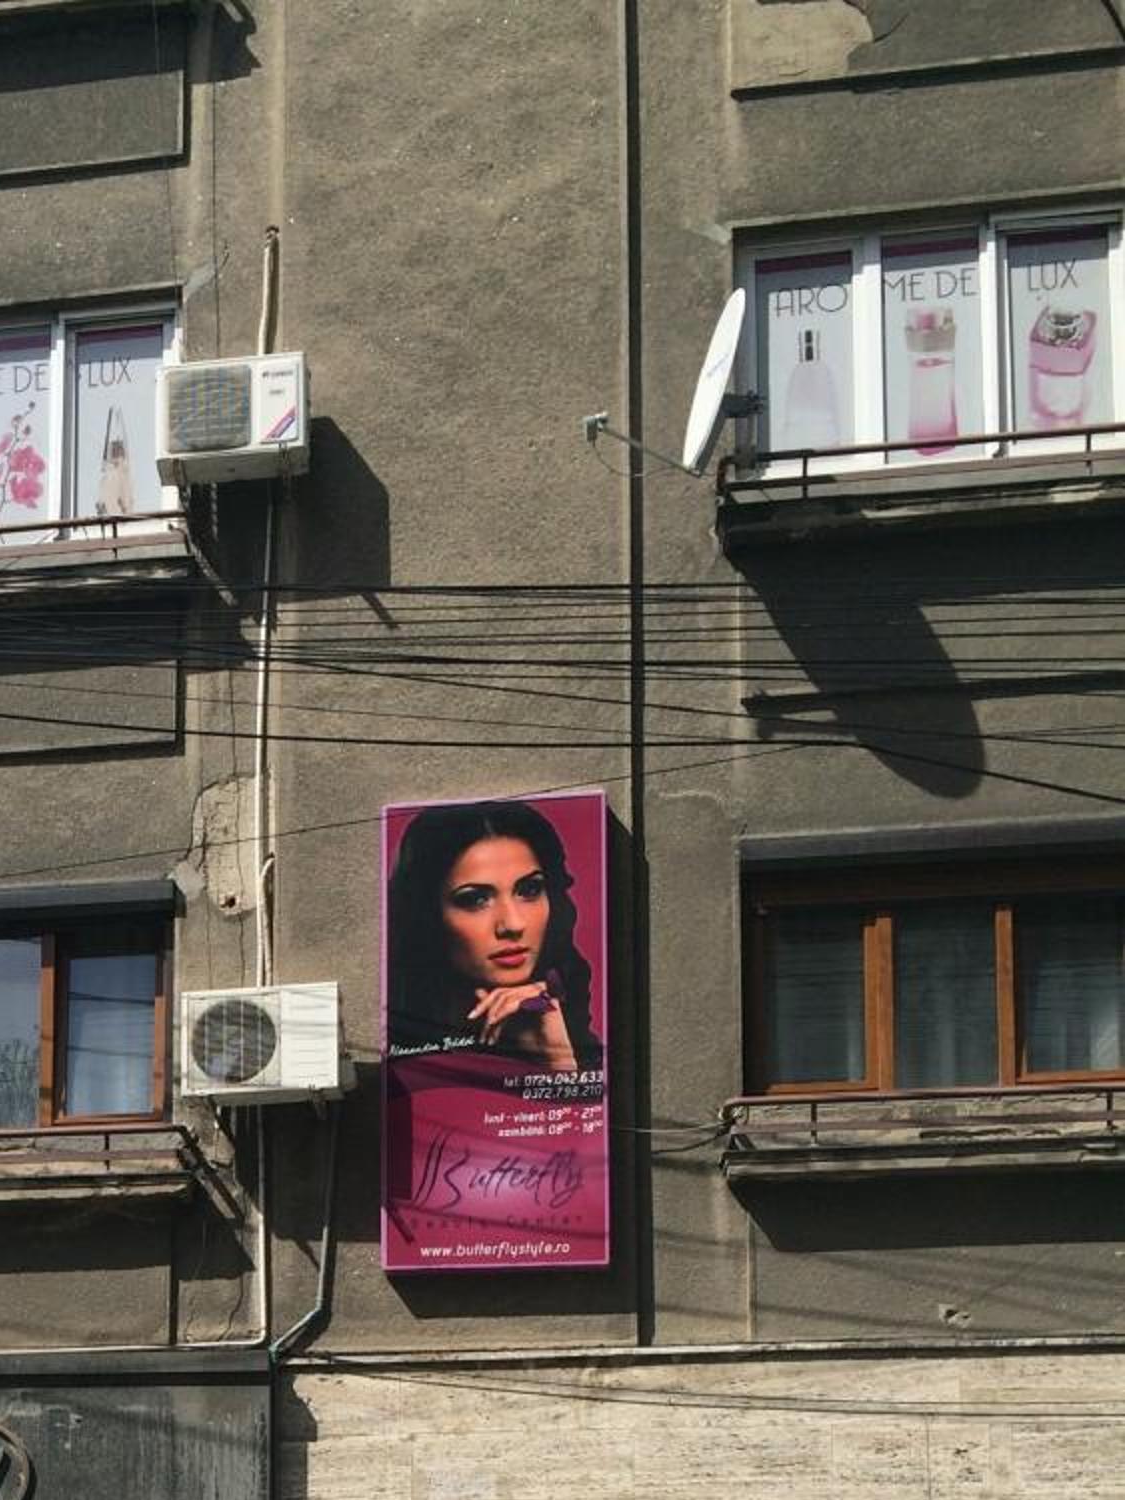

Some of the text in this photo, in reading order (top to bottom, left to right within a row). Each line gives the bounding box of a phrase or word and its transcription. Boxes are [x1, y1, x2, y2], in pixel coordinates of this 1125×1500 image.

[936, 267, 978, 298] DE
[1028, 261, 1078, 292] LUX
[14, 363, 50, 393] DE
[87, 357, 132, 388] LUX
[415, 1132, 583, 1209] Butterfly
